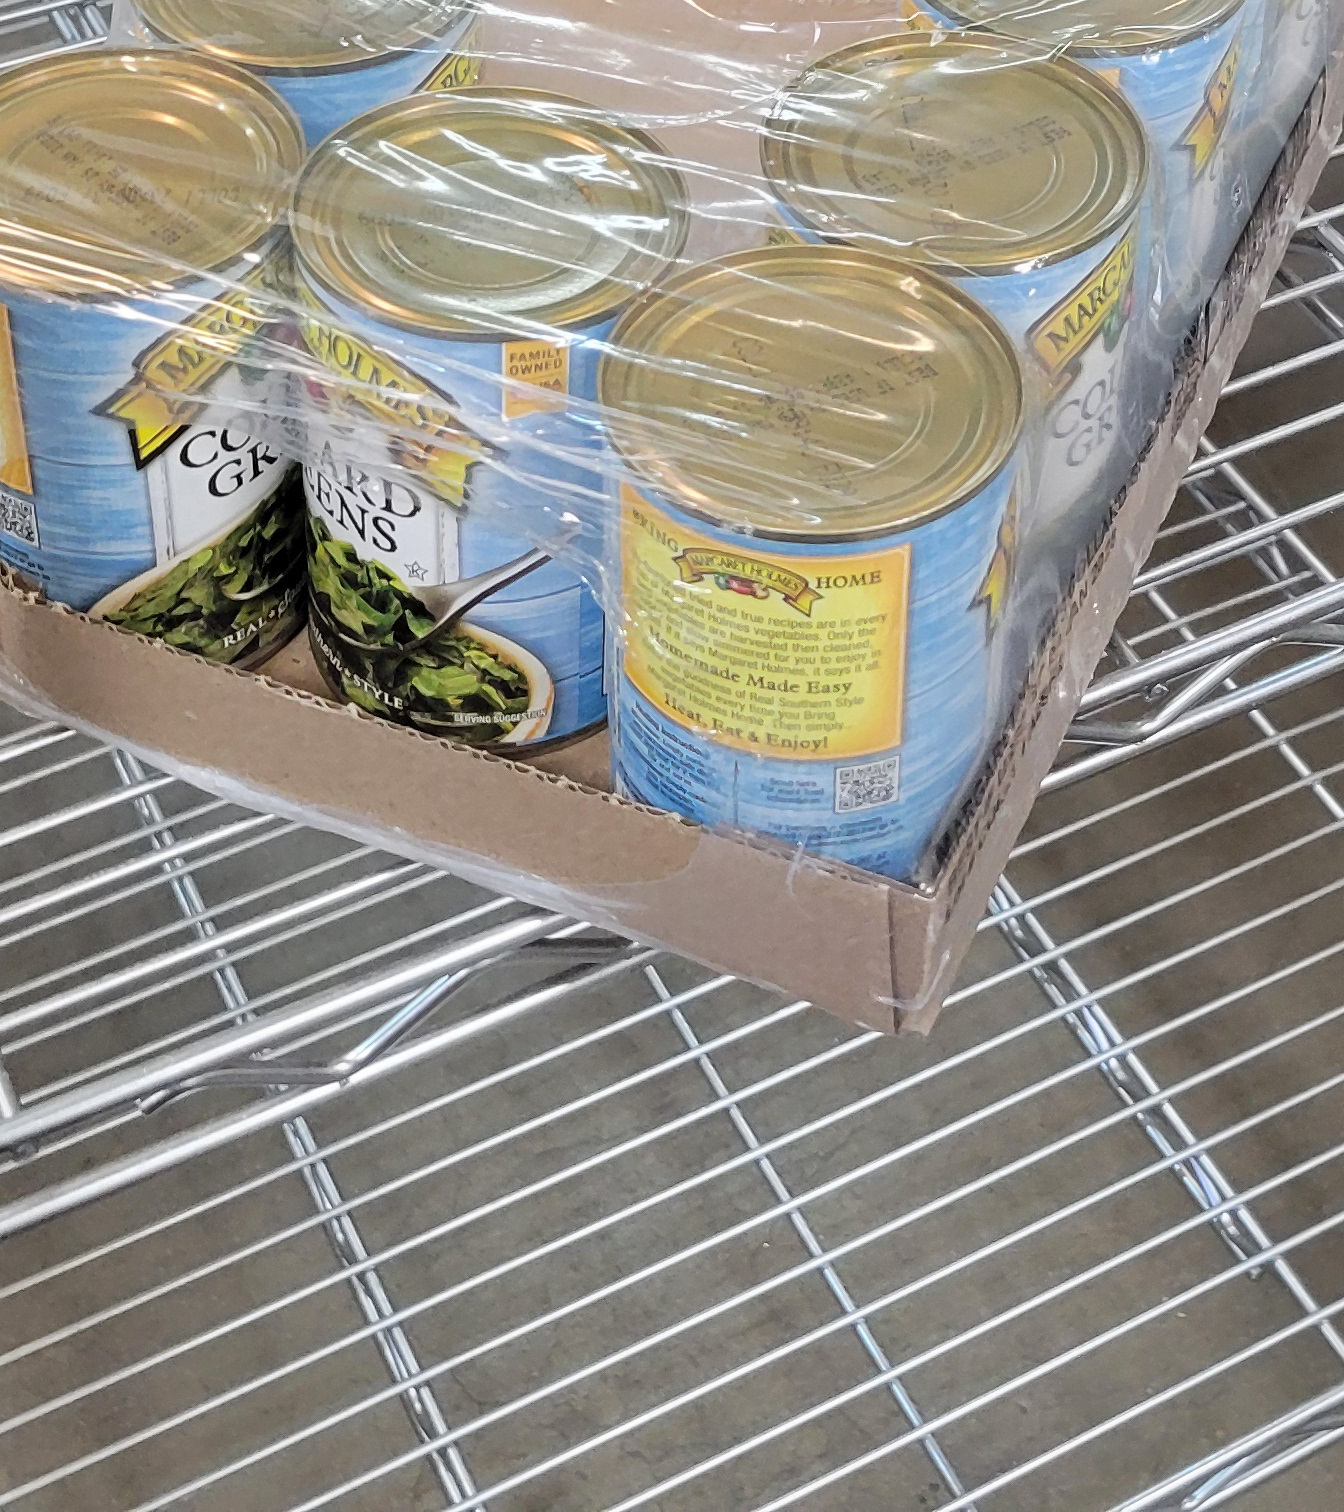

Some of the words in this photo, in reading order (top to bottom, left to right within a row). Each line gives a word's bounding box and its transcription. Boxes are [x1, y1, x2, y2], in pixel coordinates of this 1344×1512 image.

[509, 348, 561, 363] FAMILY
[509, 358, 563, 376] OWNED
[815, 569, 882, 589] HOME
[716, 603, 737, 617] and
[741, 609, 765, 624] true
[768, 616, 813, 630] recipes
[816, 619, 837, 629] are
[840, 618, 851, 628] in
[855, 613, 888, 626] every
[222, 616, 268, 649] REAL
[730, 630, 788, 652] harvested
[792, 641, 819, 653] then
[827, 630, 855, 642] Only
[648, 624, 741, 683] Homemade
[746, 673, 801, 693] Made
[806, 680, 853, 695] Easy
[794, 655, 817, 666] you
[820, 655, 832, 665] to
[835, 652, 868, 665] enjoy
[824, 666, 852, 677] says
[353, 673, 404, 710] STYLE
[749, 691, 775, 705] Real
[778, 697, 832, 709] Southern
[835, 696, 865, 708] Style
[664, 691, 708, 729] Heat,
[712, 717, 743, 739] Eat
[747, 731, 759, 743] &
[766, 731, 830, 752] Enjoy!
[778, 710, 800, 721] you
[803, 710, 836, 722] Bring
